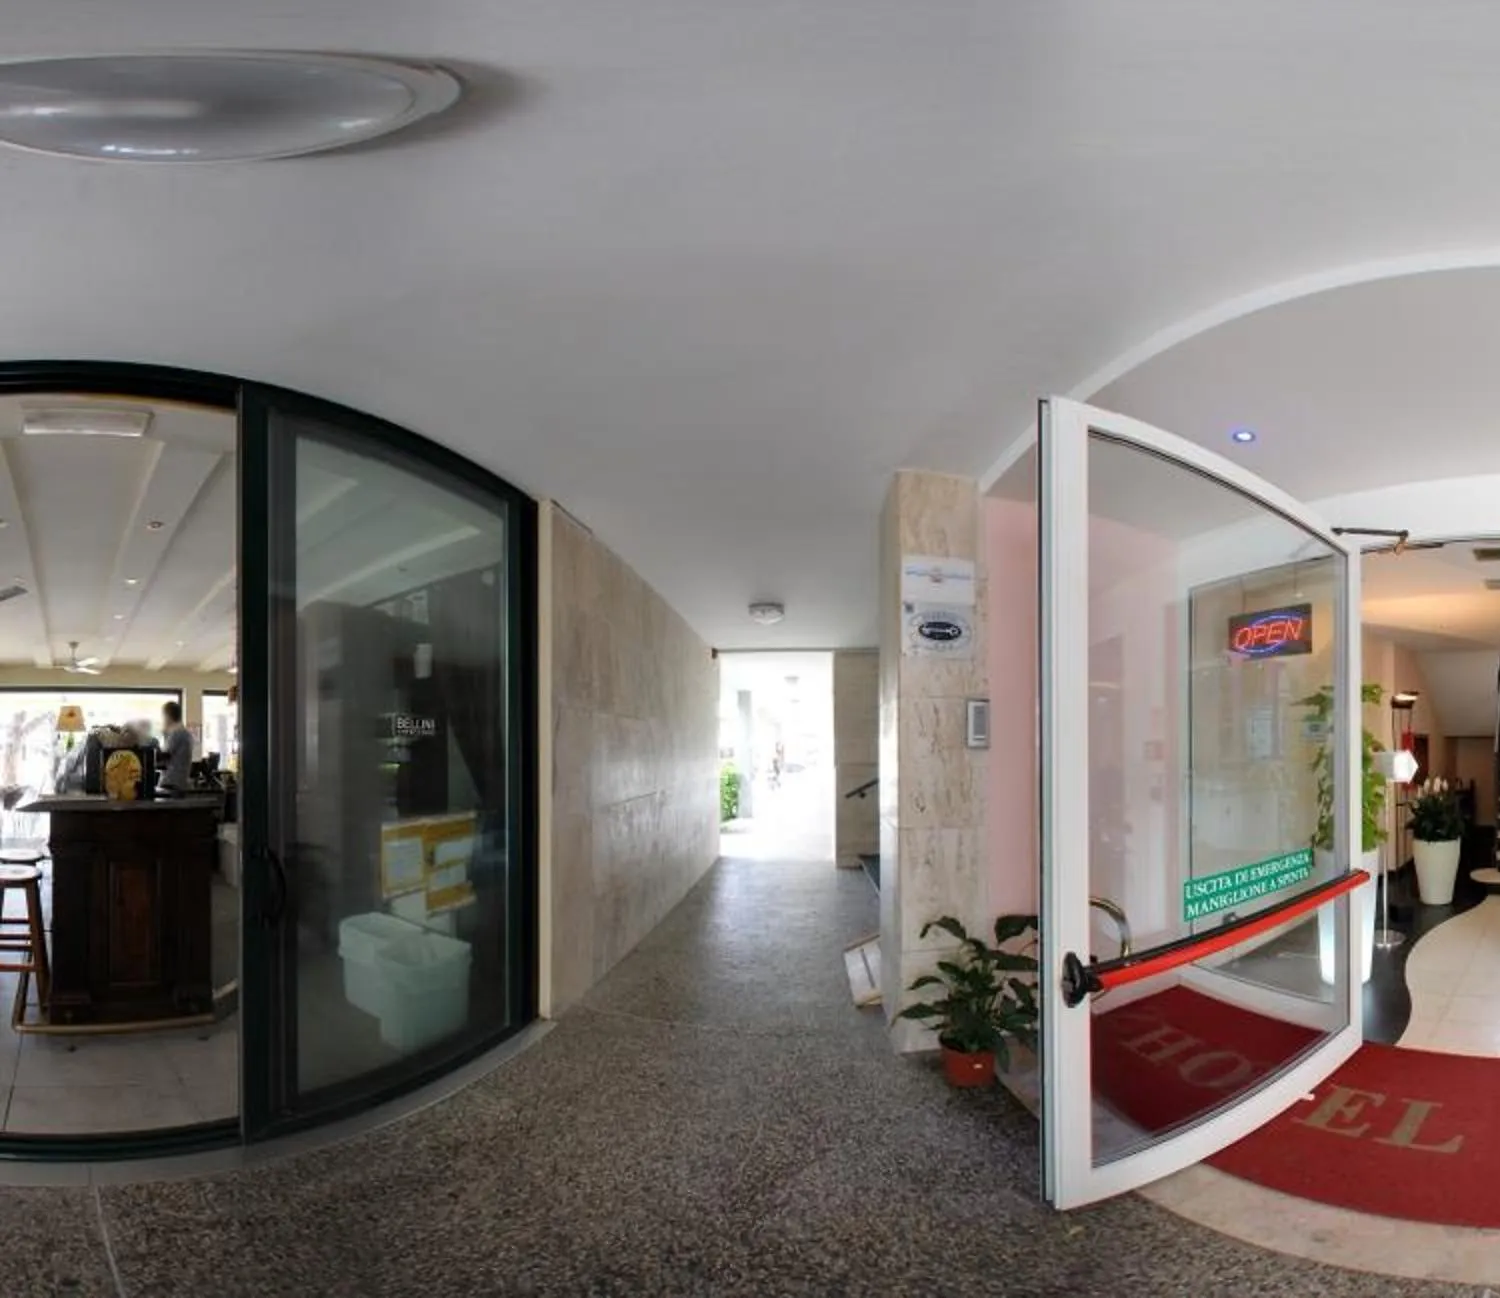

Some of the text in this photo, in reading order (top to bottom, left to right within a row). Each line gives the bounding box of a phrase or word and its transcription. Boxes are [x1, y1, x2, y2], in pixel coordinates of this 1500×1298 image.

[1235, 619, 1302, 650] OPEN
[1185, 853, 1310, 899] USCITA DI EMERGENZA
[1186, 866, 1310, 917] MANIGLIONE A SPINTA
[1120, 1024, 1463, 1153] HOEL
